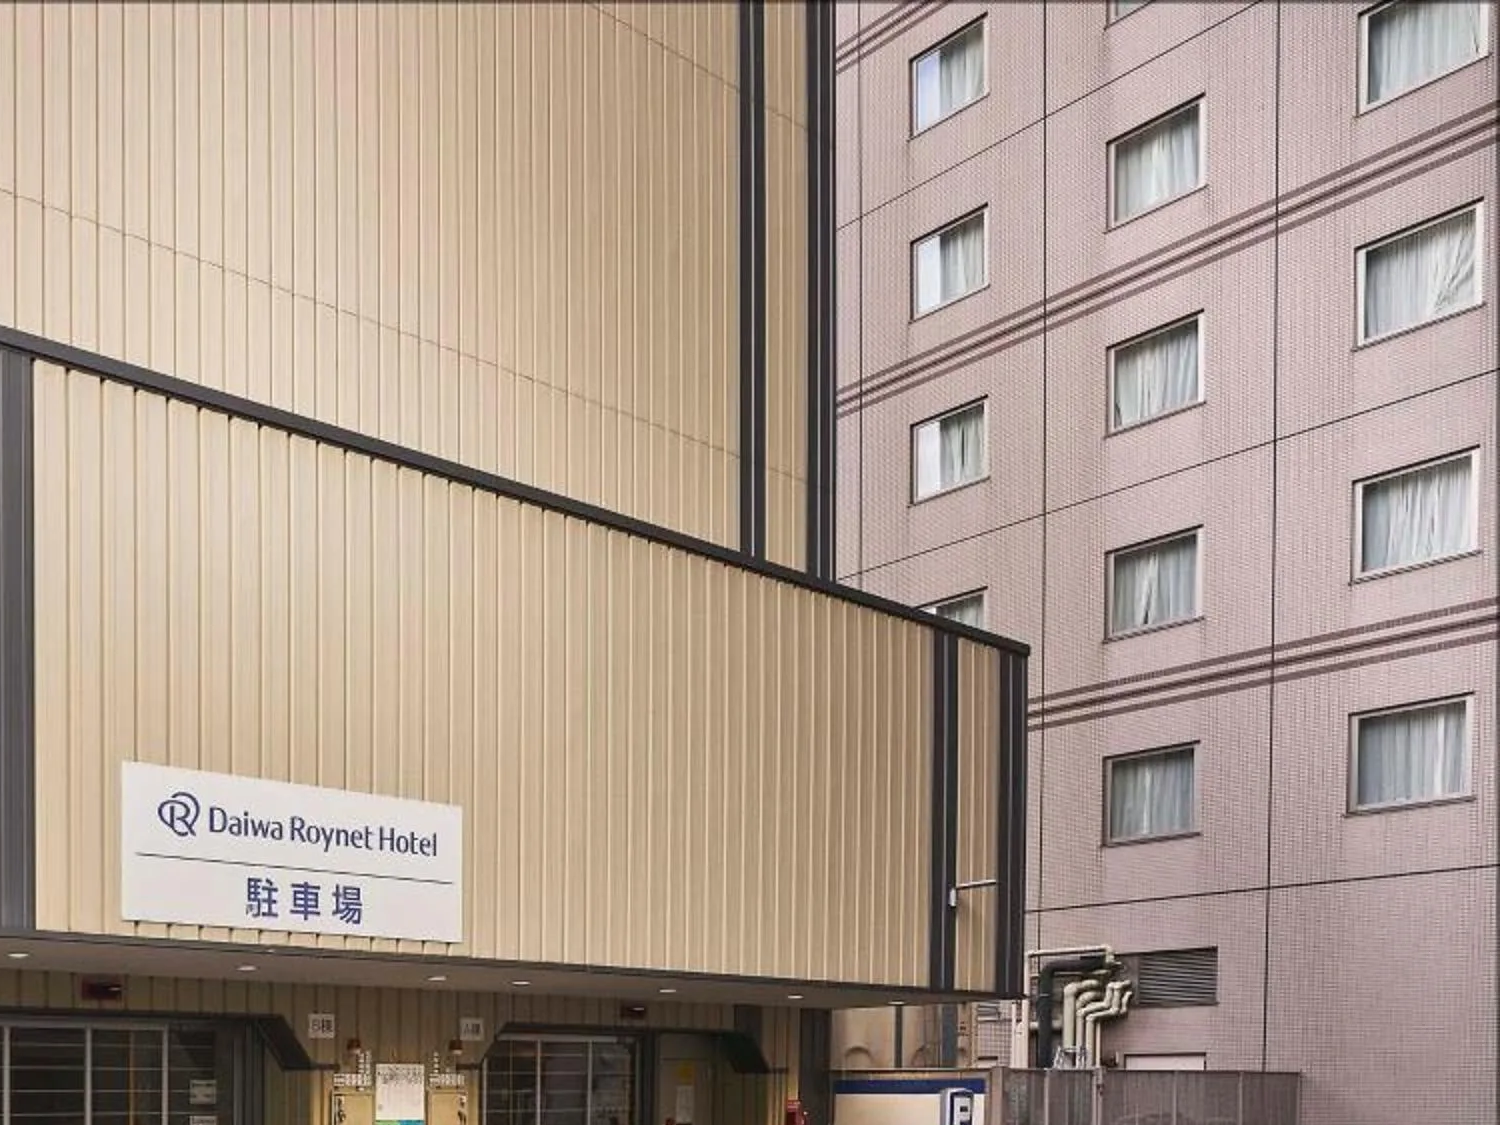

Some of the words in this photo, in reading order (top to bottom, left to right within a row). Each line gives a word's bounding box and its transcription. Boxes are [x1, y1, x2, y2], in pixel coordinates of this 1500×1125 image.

[208, 807, 283, 842] Daiwa
[290, 816, 374, 852] Roynet
[379, 827, 438, 857] Hotel
[246, 876, 363, 925] 駐車場
